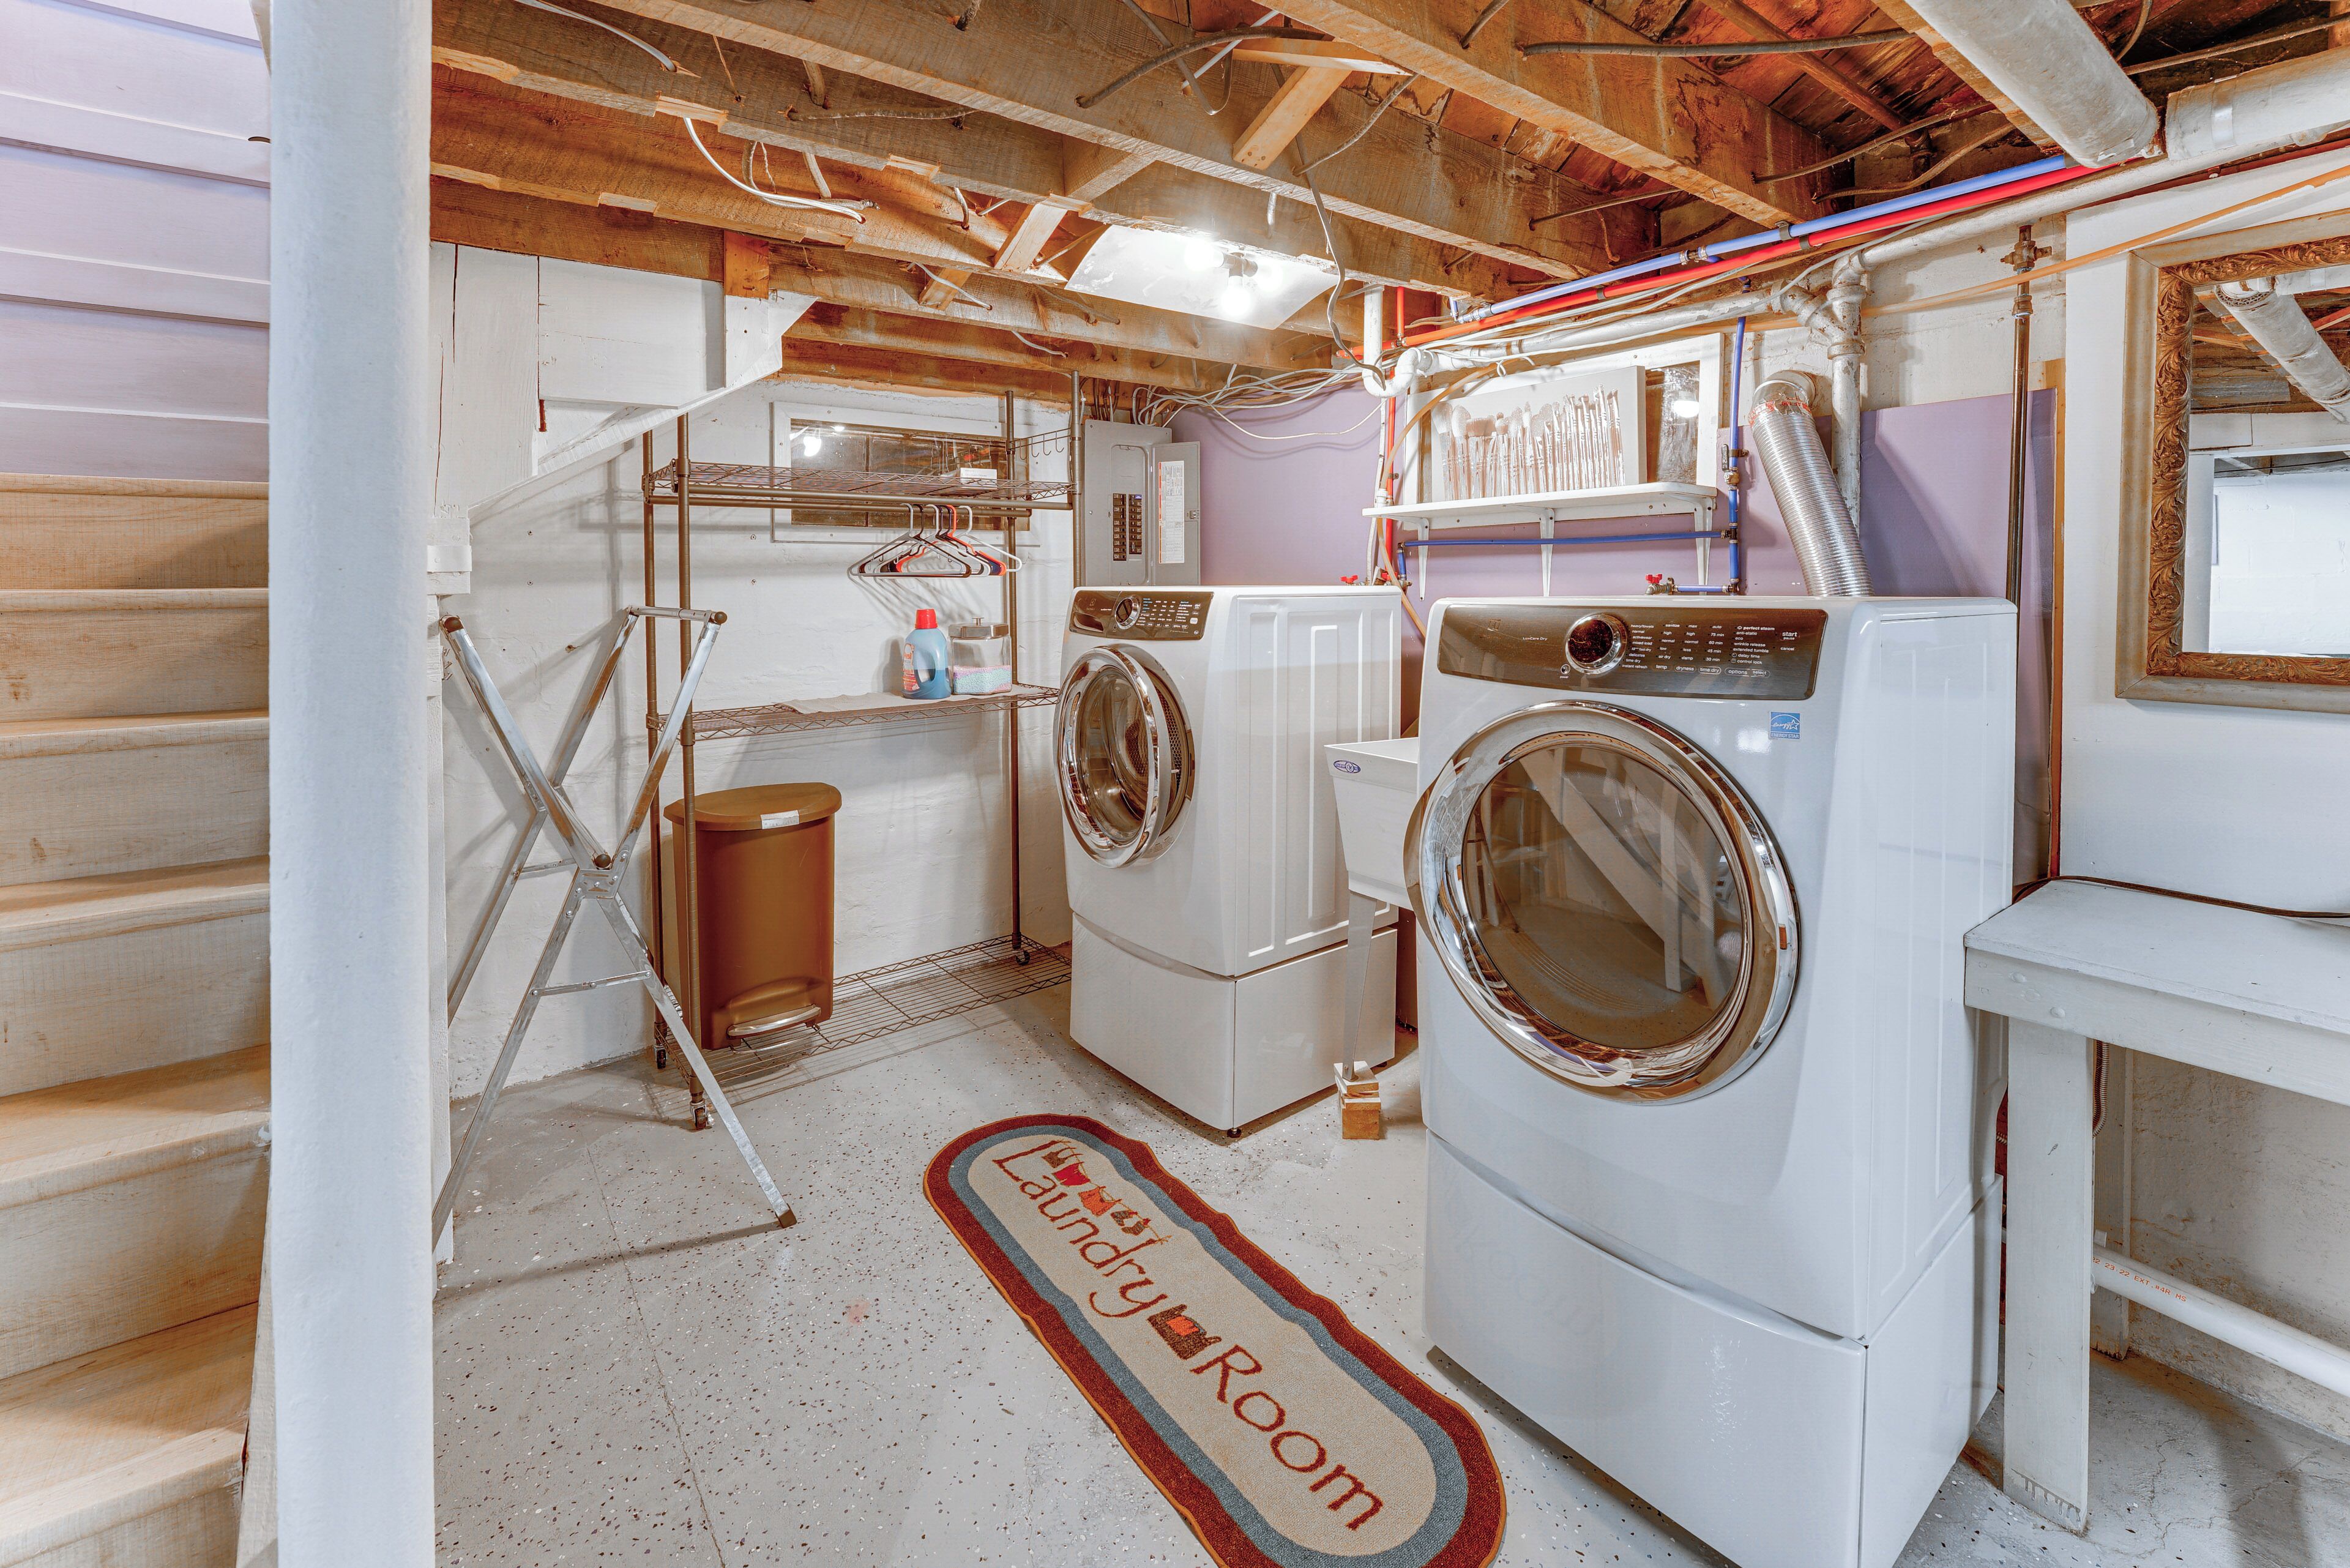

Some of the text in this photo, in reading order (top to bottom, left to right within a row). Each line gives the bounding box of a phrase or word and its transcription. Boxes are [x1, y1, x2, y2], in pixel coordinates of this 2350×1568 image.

[992, 1140, 1384, 1531] Laundry Room
[2175, 1293, 2187, 1302] MS
